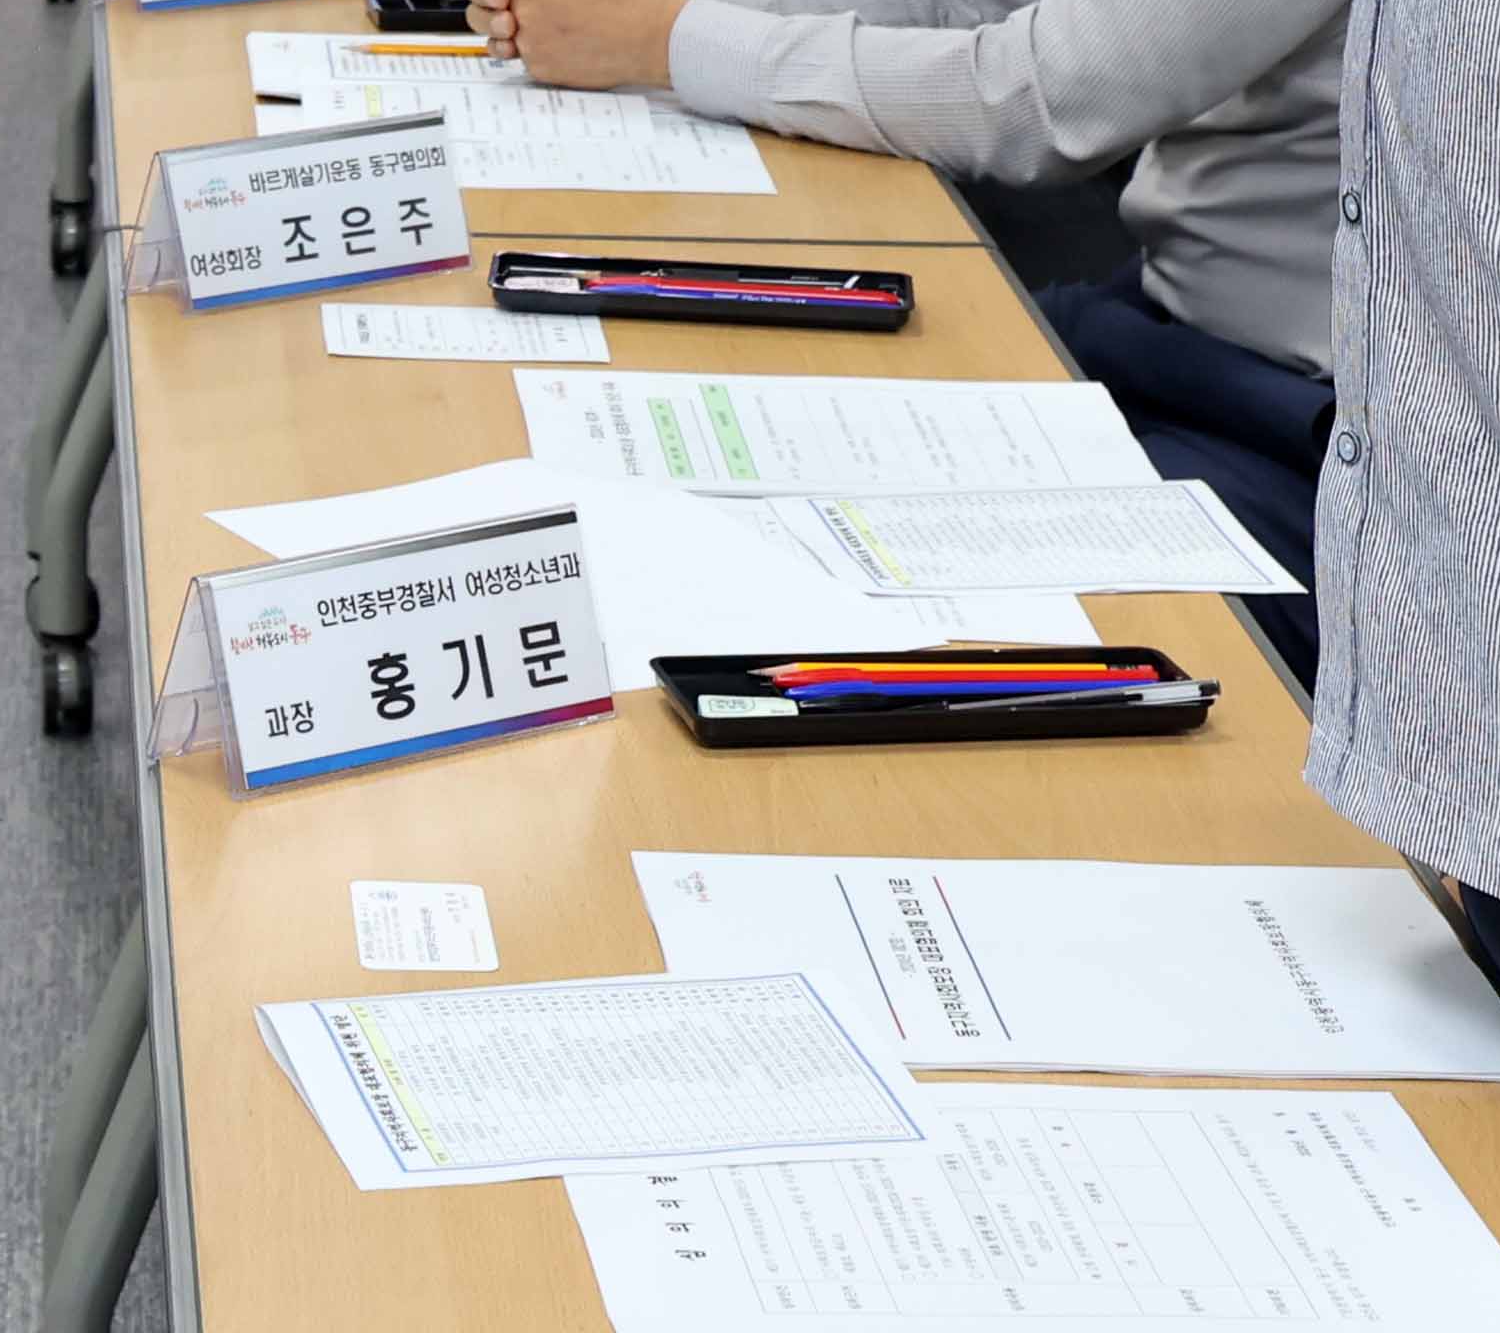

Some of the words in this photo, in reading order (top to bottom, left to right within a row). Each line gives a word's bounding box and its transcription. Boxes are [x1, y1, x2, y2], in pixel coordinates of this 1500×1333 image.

[248, 158, 362, 195] 바르게살기운동
[369, 144, 447, 180] 동구협의회
[190, 244, 262, 278] 여성회장
[282, 196, 435, 265] 조은주
[316, 575, 457, 629] 인천중부경찰서
[464, 552, 581, 599] 여성청소년과
[264, 699, 314, 739] 과장
[366, 620, 570, 720] 홍기문
